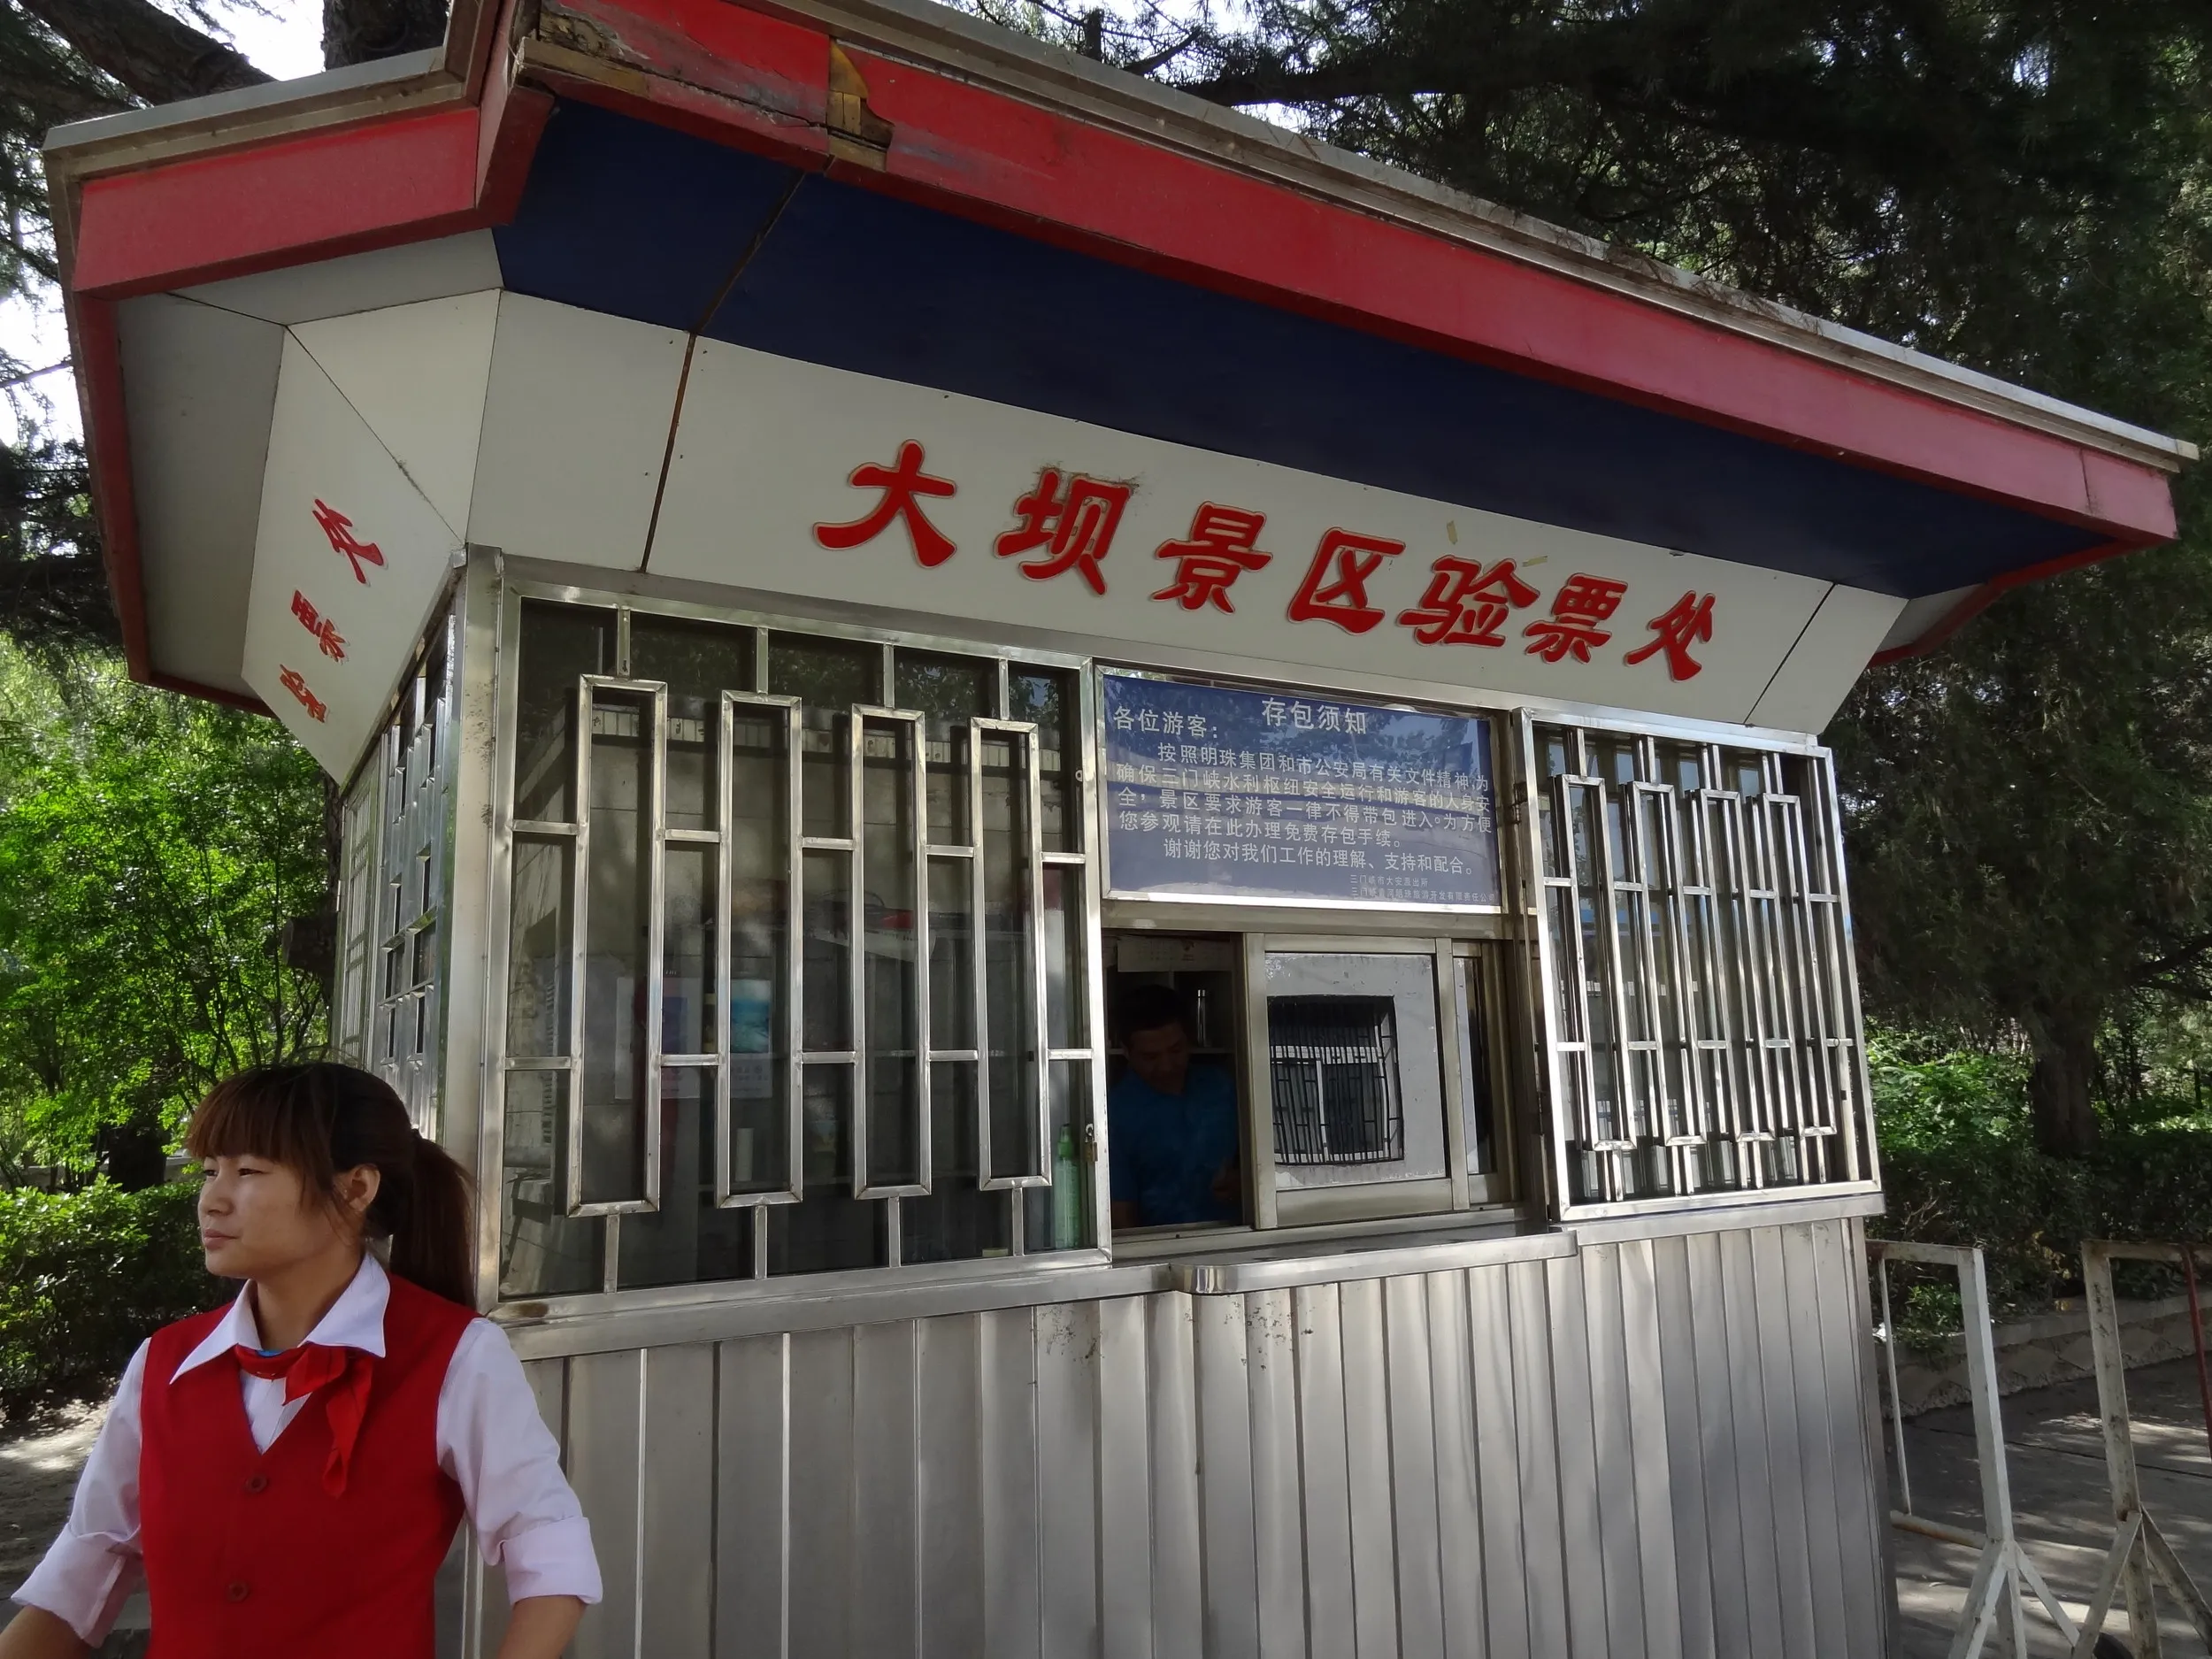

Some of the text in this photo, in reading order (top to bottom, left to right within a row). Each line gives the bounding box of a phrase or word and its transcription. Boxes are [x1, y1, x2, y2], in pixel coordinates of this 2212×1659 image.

[812, 439, 1717, 682] 大坝景区验票处
[1261, 695, 1367, 736] 存包须知
[1116, 763, 1492, 813] 确保三门峡水利枢纽安全运行和游客的人身安
